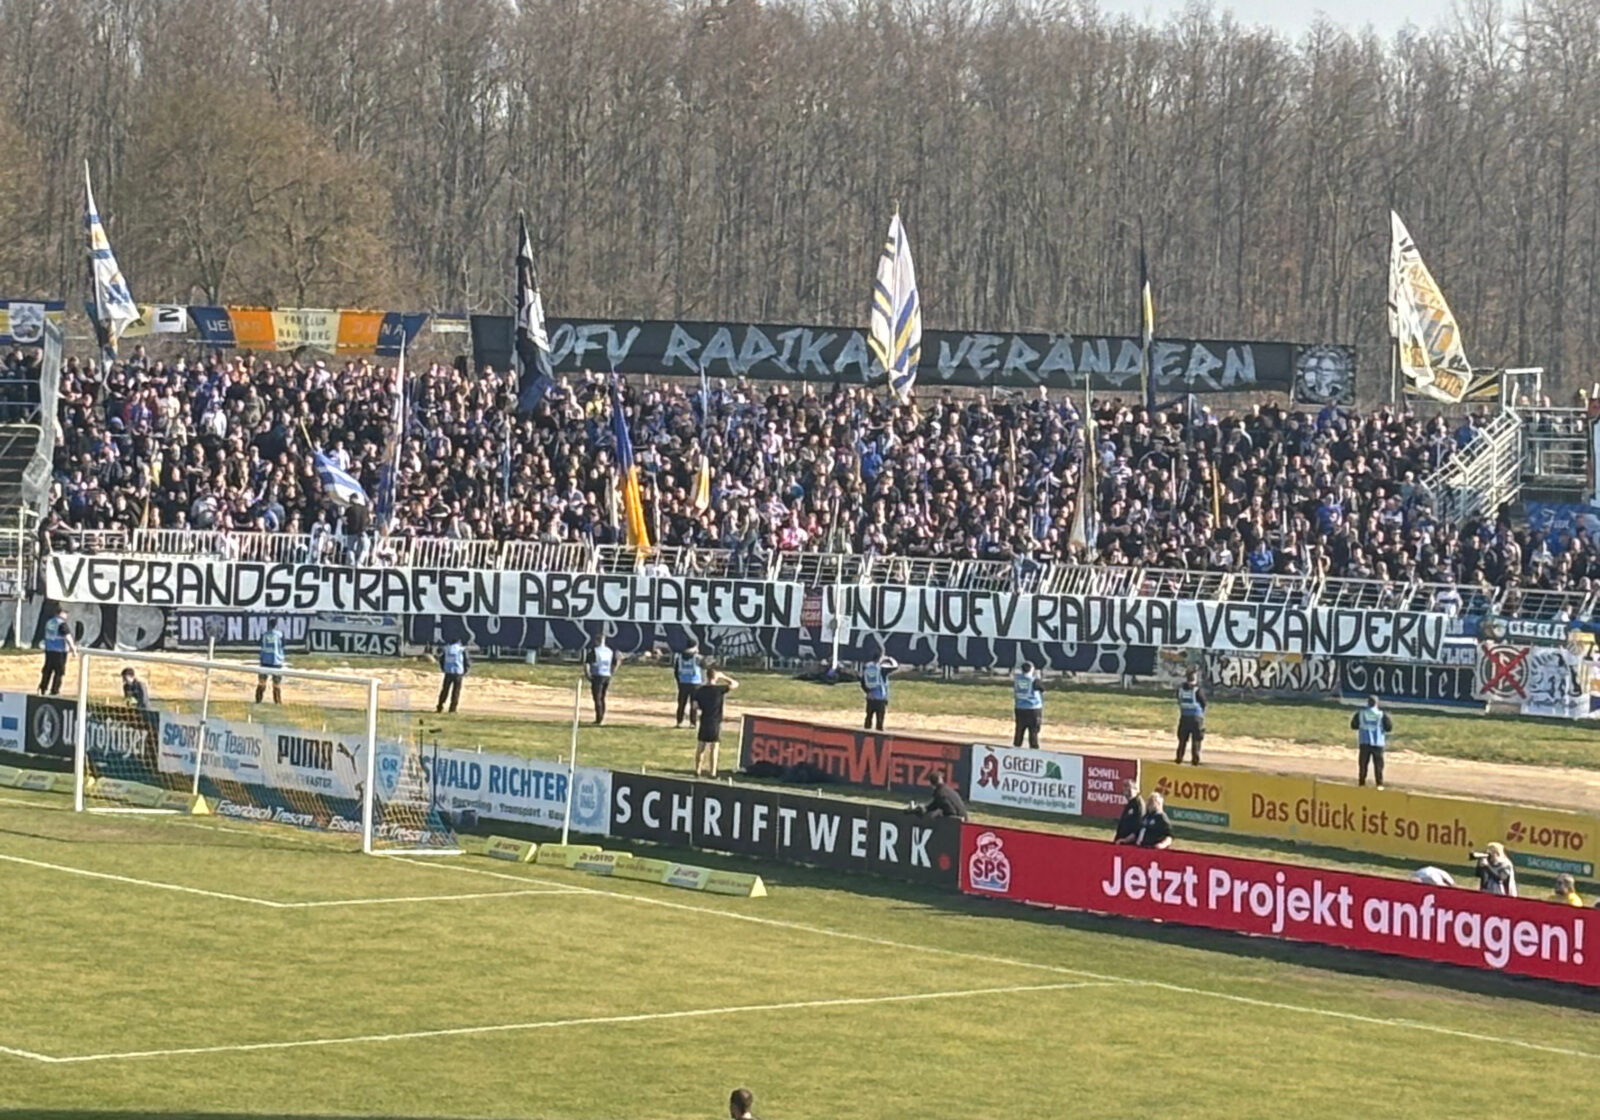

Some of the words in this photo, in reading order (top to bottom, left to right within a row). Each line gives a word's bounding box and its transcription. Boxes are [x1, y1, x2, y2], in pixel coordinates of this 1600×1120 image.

[938, 330, 1258, 390] VERÄNDERN
[52, 555, 500, 616] VERBANDSSTRAFEN
[518, 571, 794, 628] ABSCHAFFEN
[1031, 593, 1192, 645] RADIKAL
[248, 617, 308, 641] MND
[312, 630, 398, 656] ULTRAS
[225, 730, 262, 758] Teams
[277, 735, 333, 771] PUMA
[1002, 755, 1044, 774] GREIF
[1088, 766, 1120, 780] SCHNELL
[488, 764, 568, 803] RICHTER
[1001, 777, 1077, 799] APOTHEKE
[1174, 780, 1220, 802] LOTTO
[1251, 793, 1289, 822] Das
[1295, 797, 1355, 832] Glück
[1361, 804, 1389, 834] ist
[1394, 813, 1420, 838] so
[1426, 815, 1475, 848] nah.
[1530, 826, 1584, 850] LOTTO
[972, 858, 1007, 882] SPS
[1102, 856, 1199, 908] Jetzt
[1208, 868, 1354, 933] Projekt
[1363, 894, 1586, 968] anfragen!
